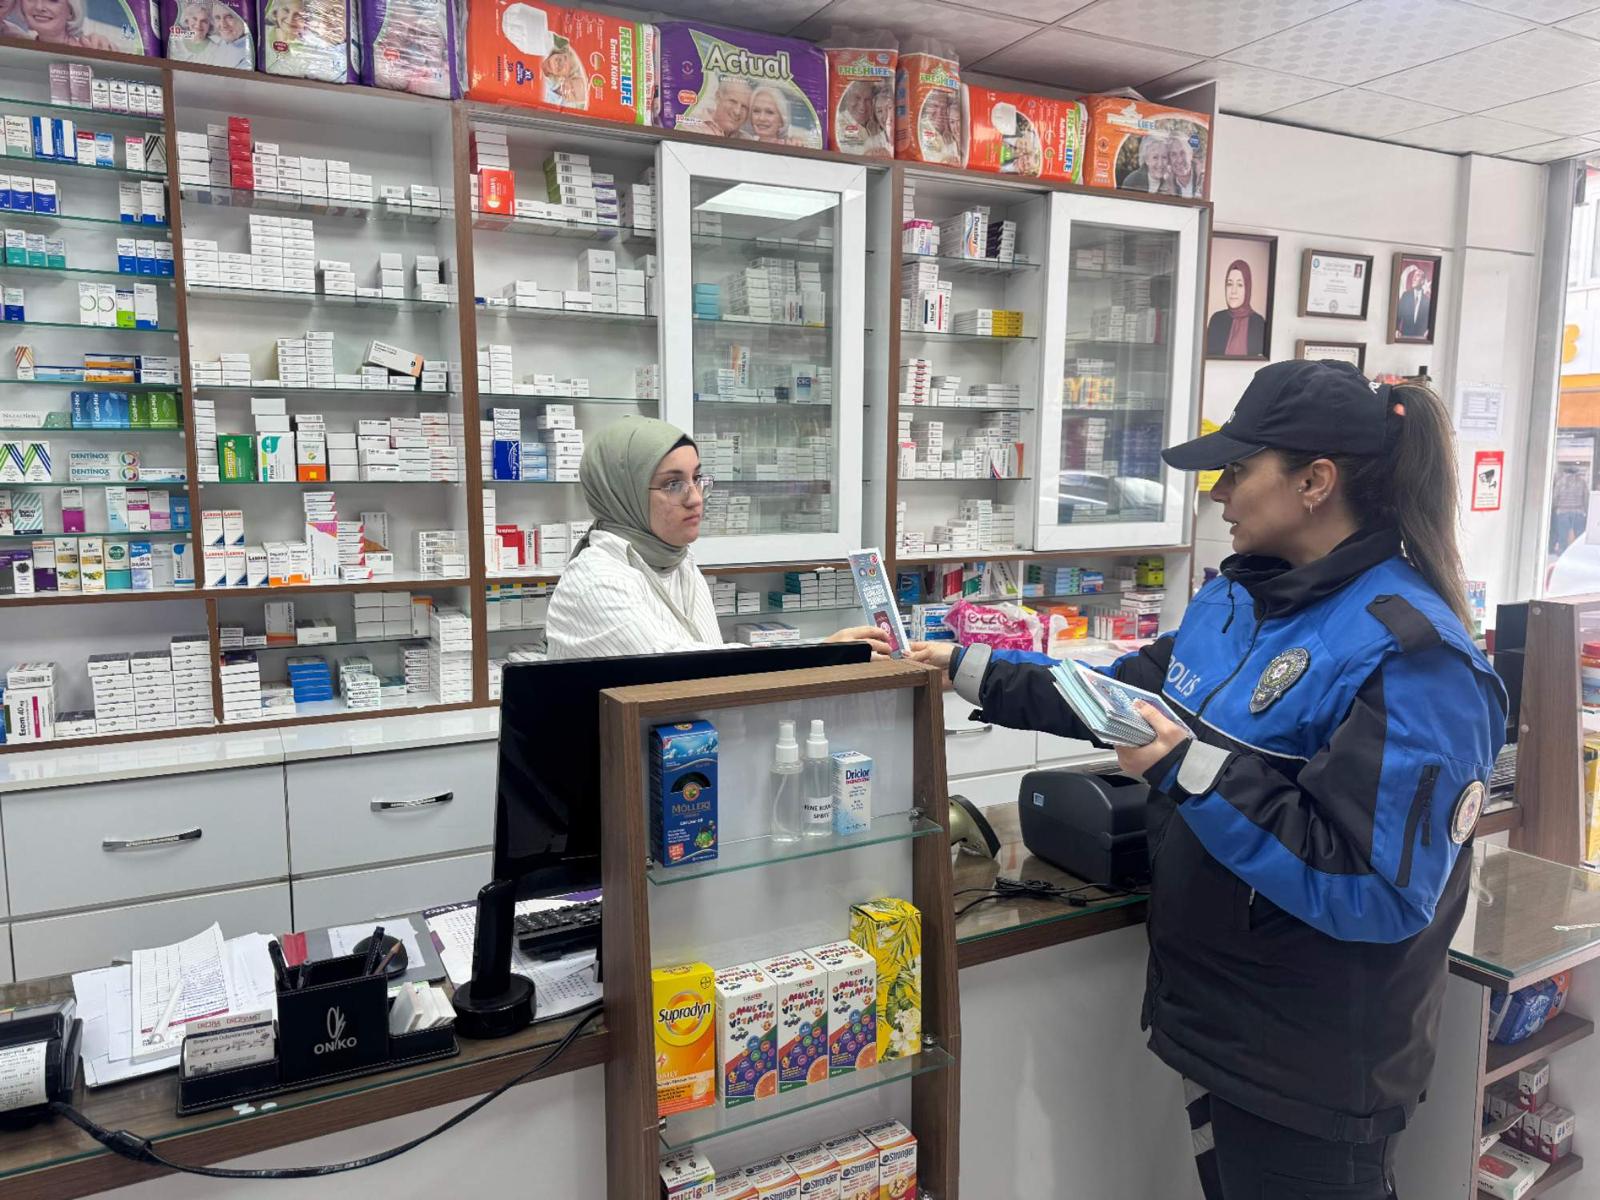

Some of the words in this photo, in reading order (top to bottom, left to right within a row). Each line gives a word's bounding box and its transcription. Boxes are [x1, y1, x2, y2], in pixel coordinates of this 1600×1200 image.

[619, 26, 633, 107] FRESHLIFE
[705, 44, 791, 80] Actual
[18, 717, 26, 736] Esom
[846, 768, 870, 780] Driclor
[658, 1001, 711, 1023] Supradyn
[889, 1146, 915, 1161] Stronger
[851, 1159, 877, 1174] Stronger
[810, 1173, 838, 1189] Stronger
